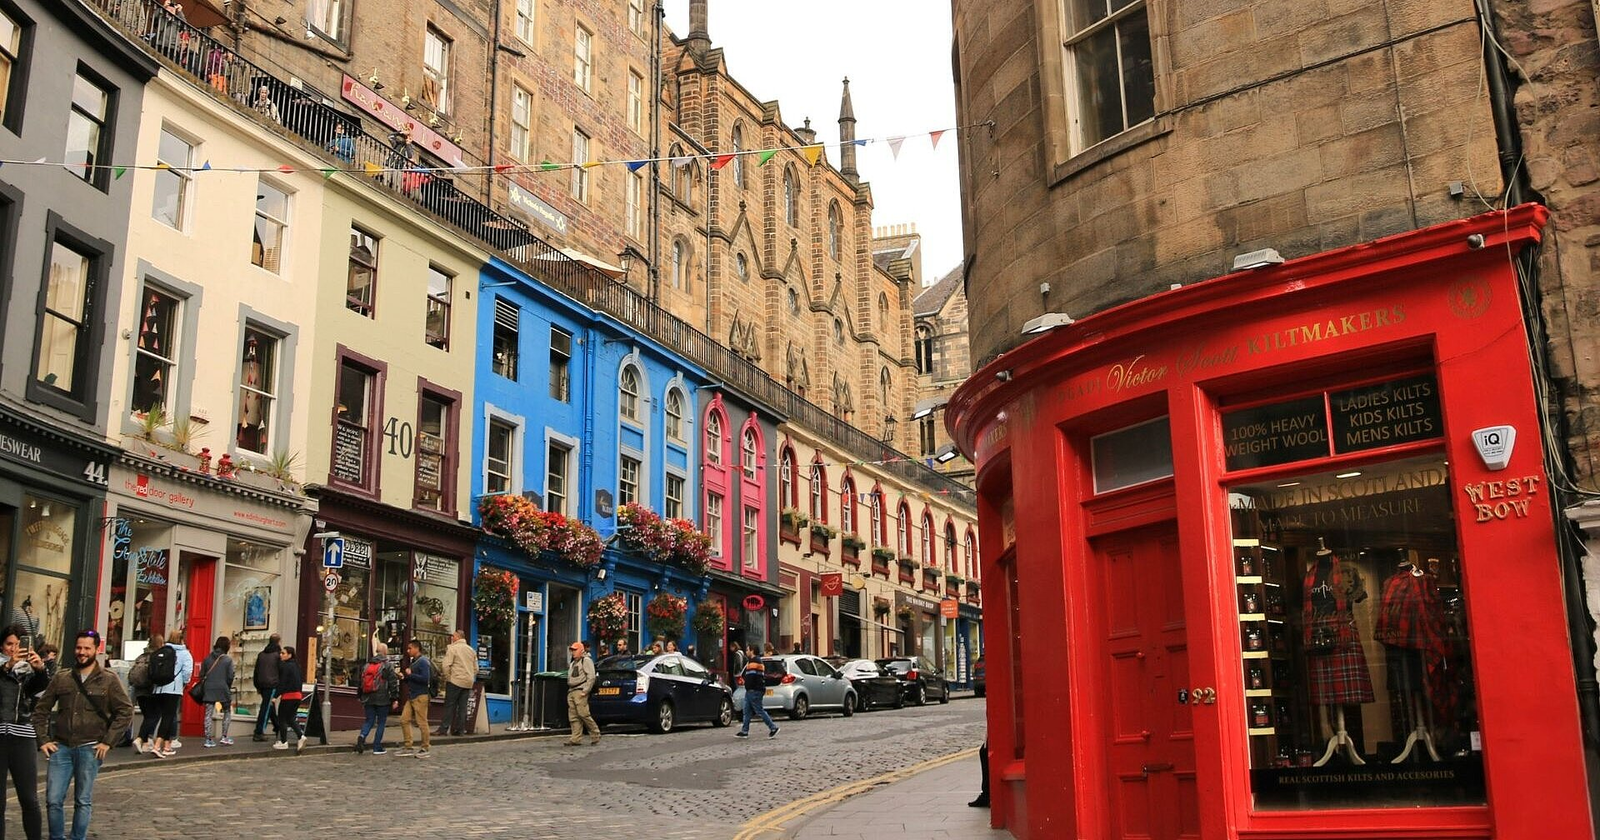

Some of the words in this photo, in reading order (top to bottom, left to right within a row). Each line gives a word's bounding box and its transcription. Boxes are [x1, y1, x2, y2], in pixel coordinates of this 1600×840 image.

[1107, 354, 1168, 394] Victor
[1175, 341, 1239, 377] Scott
[1247, 305, 1407, 355] KILTMAKERS
[1340, 393, 1388, 412] LADIES
[1393, 382, 1431, 402] KILTS
[1231, 421, 1268, 441] 100%
[1271, 413, 1316, 435] HEAVY
[1350, 410, 1383, 428] KIDS
[1386, 402, 1425, 419] KILTS
[383, 417, 412, 459] 40
[1225, 437, 1278, 457] WEIGHT
[1284, 429, 1327, 448] WOOL
[1346, 427, 1390, 446] MENS
[1394, 418, 1433, 437] KILTS
[1484, 432, 1500, 447] iQ
[125, 480, 136, 492] the
[136, 483, 148, 495] red
[149, 486, 166, 500] door
[169, 492, 195, 508] gallery
[1239, 492, 1294, 514] MADE
[1300, 485, 1322, 505] IN
[1327, 468, 1444, 501] SCOTLAND
[1465, 475, 1540, 503] WEST
[1260, 516, 1304, 533] MADE
[1314, 510, 1335, 526] TO
[1341, 498, 1425, 523] MEASURE
[1475, 497, 1532, 523] BOW
[326, 577, 337, 587] 20
[1192, 686, 1216, 705] 92
[1278, 775, 1300, 785] REAL
[1301, 774, 1345, 784] SCOTTISH
[1347, 773, 1373, 783] KILTS
[1375, 772, 1395, 781] AND
[1397, 770, 1455, 780] ACCESORIES
